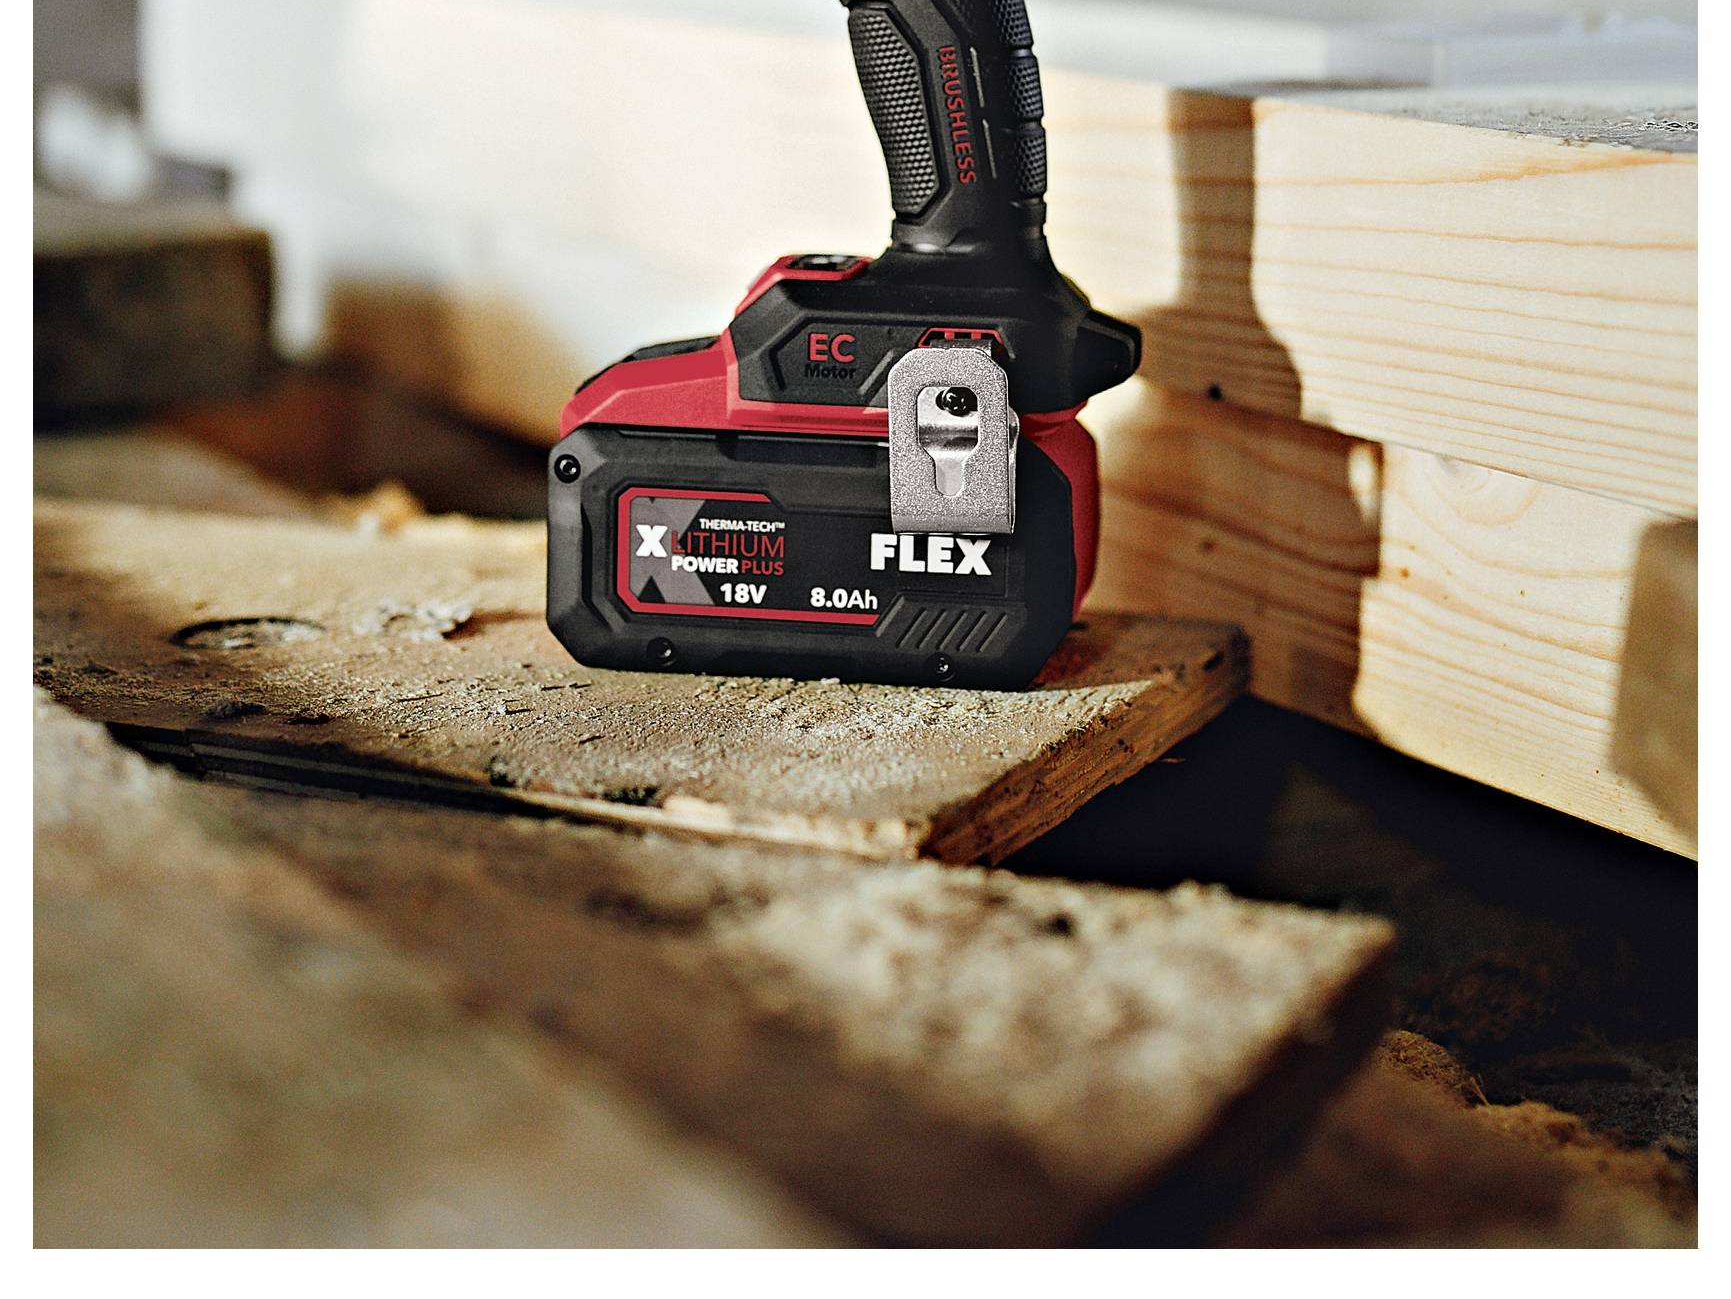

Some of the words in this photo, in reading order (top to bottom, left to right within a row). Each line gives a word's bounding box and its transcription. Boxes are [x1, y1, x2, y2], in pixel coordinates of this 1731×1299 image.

[938, 44, 977, 186] BRUSHLESS
[809, 332, 856, 363] EC
[804, 363, 857, 380] Motor
[635, 524, 668, 558] X
[671, 530, 785, 558] LITHIUM
[870, 532, 993, 576] FLEX
[671, 555, 739, 575] POWER
[741, 559, 785, 577] PLUS
[719, 582, 768, 605] 18V
[809, 586, 879, 611] 8.0Ah
